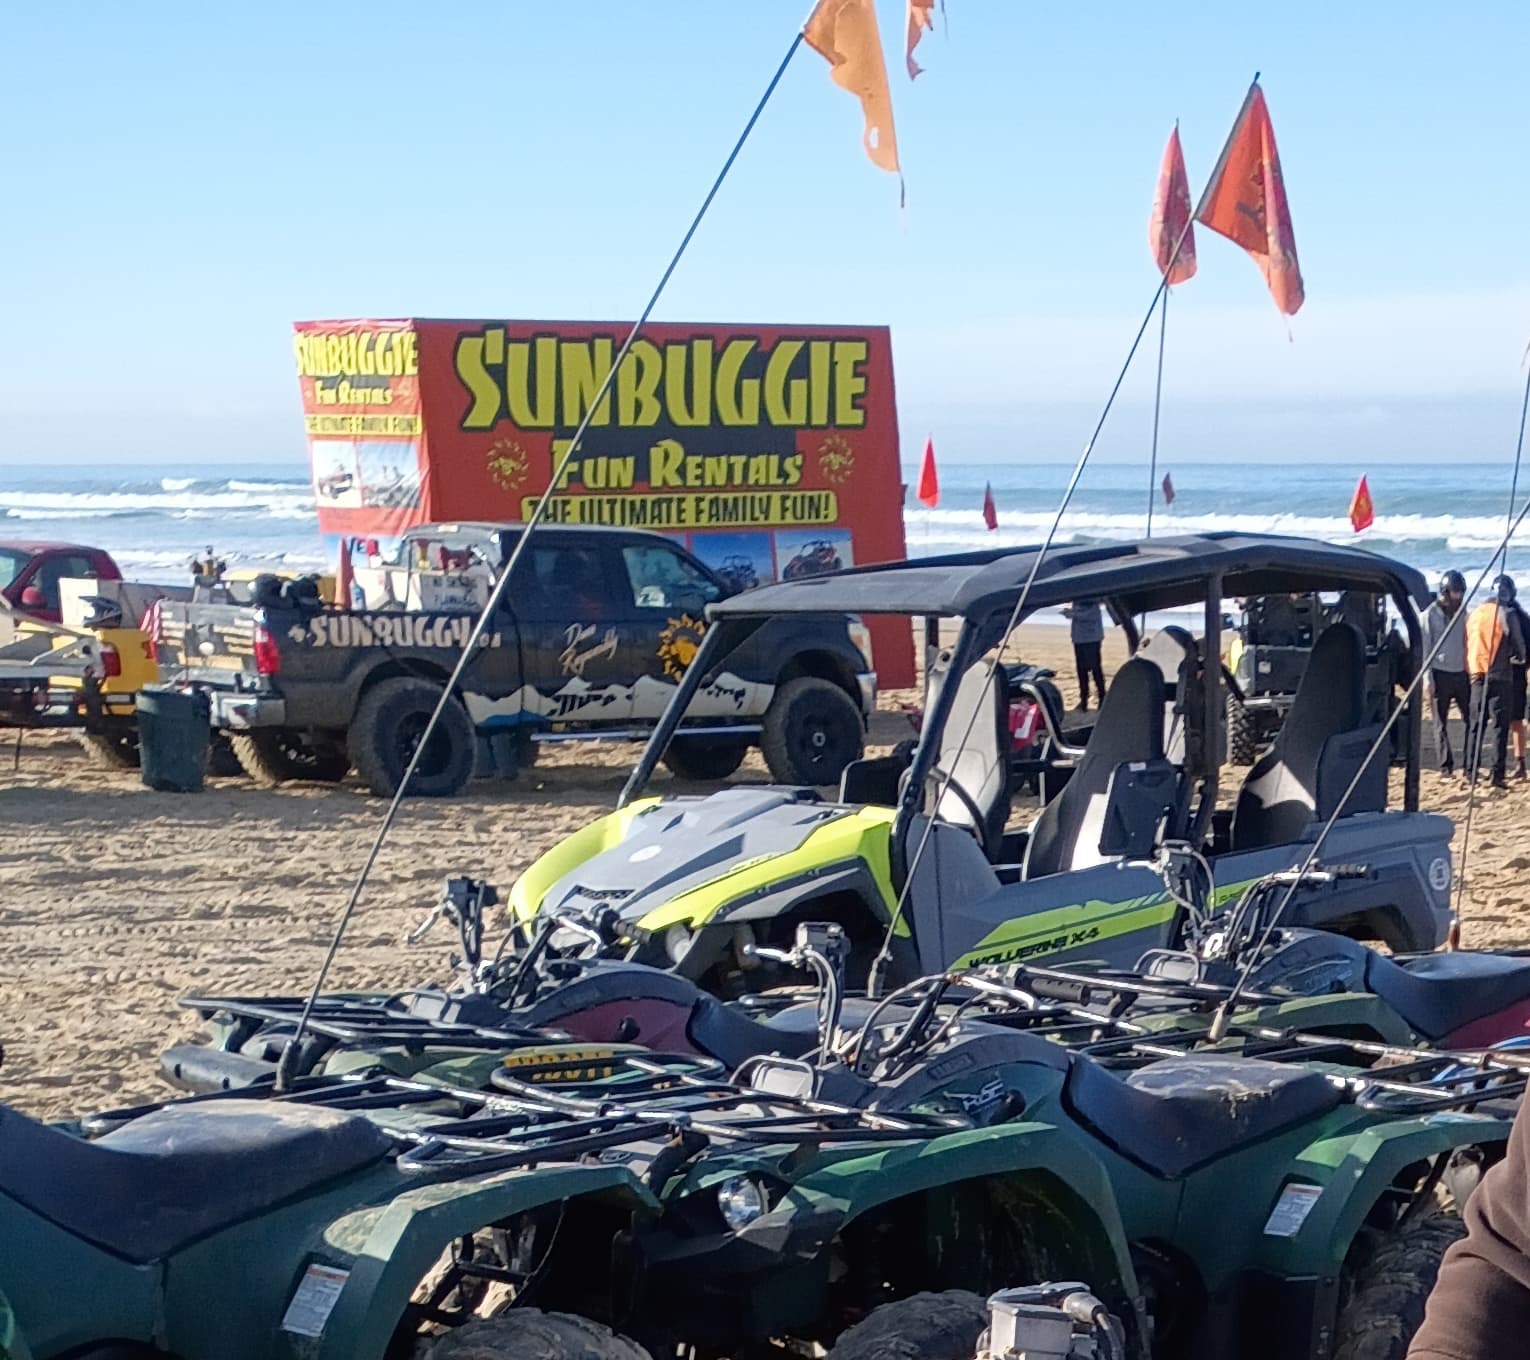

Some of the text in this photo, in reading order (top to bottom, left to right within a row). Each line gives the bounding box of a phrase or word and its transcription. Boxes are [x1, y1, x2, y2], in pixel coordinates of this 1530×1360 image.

[455, 329, 868, 428] SUNBUGGIE
[552, 438, 803, 489] FUN RENTALS
[580, 497, 687, 526] ULTIMATE
[694, 495, 773, 523] FAMILY
[779, 493, 831, 521] FUN!
